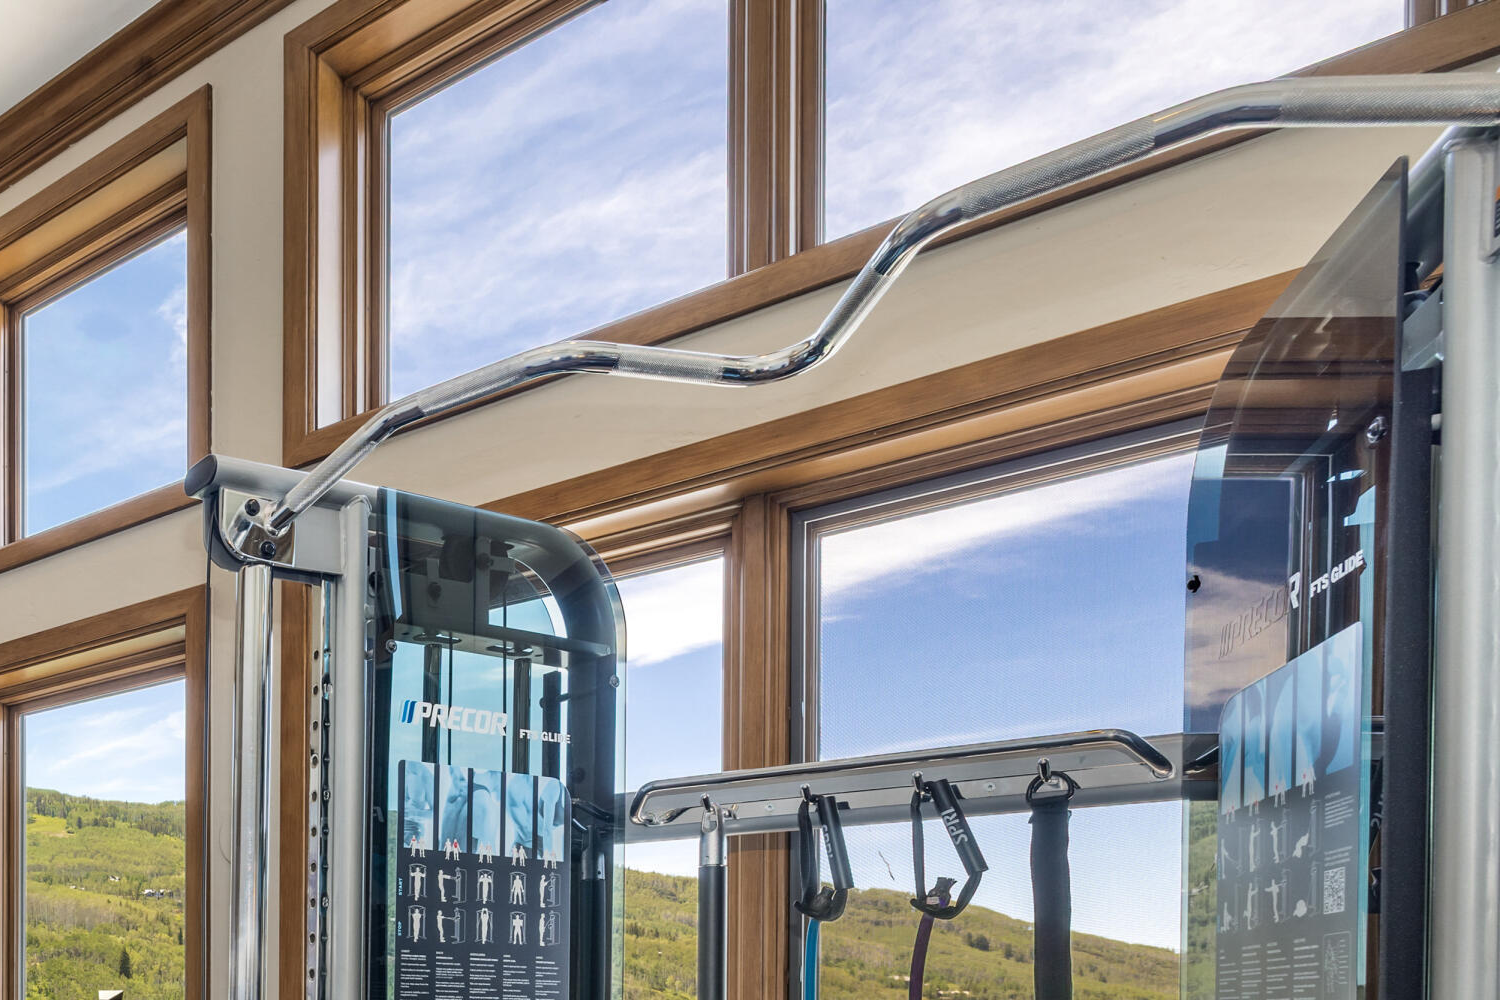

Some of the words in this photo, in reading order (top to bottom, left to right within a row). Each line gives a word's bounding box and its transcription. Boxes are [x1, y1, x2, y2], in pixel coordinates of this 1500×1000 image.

[1309, 573, 1330, 598] FTS
[1330, 549, 1364, 583] GLIDE
[413, 701, 509, 736] PRECOR
[540, 730, 572, 745] GLIDE
[322, 790, 330, 801] 9
[941, 807, 968, 846] SPRI
